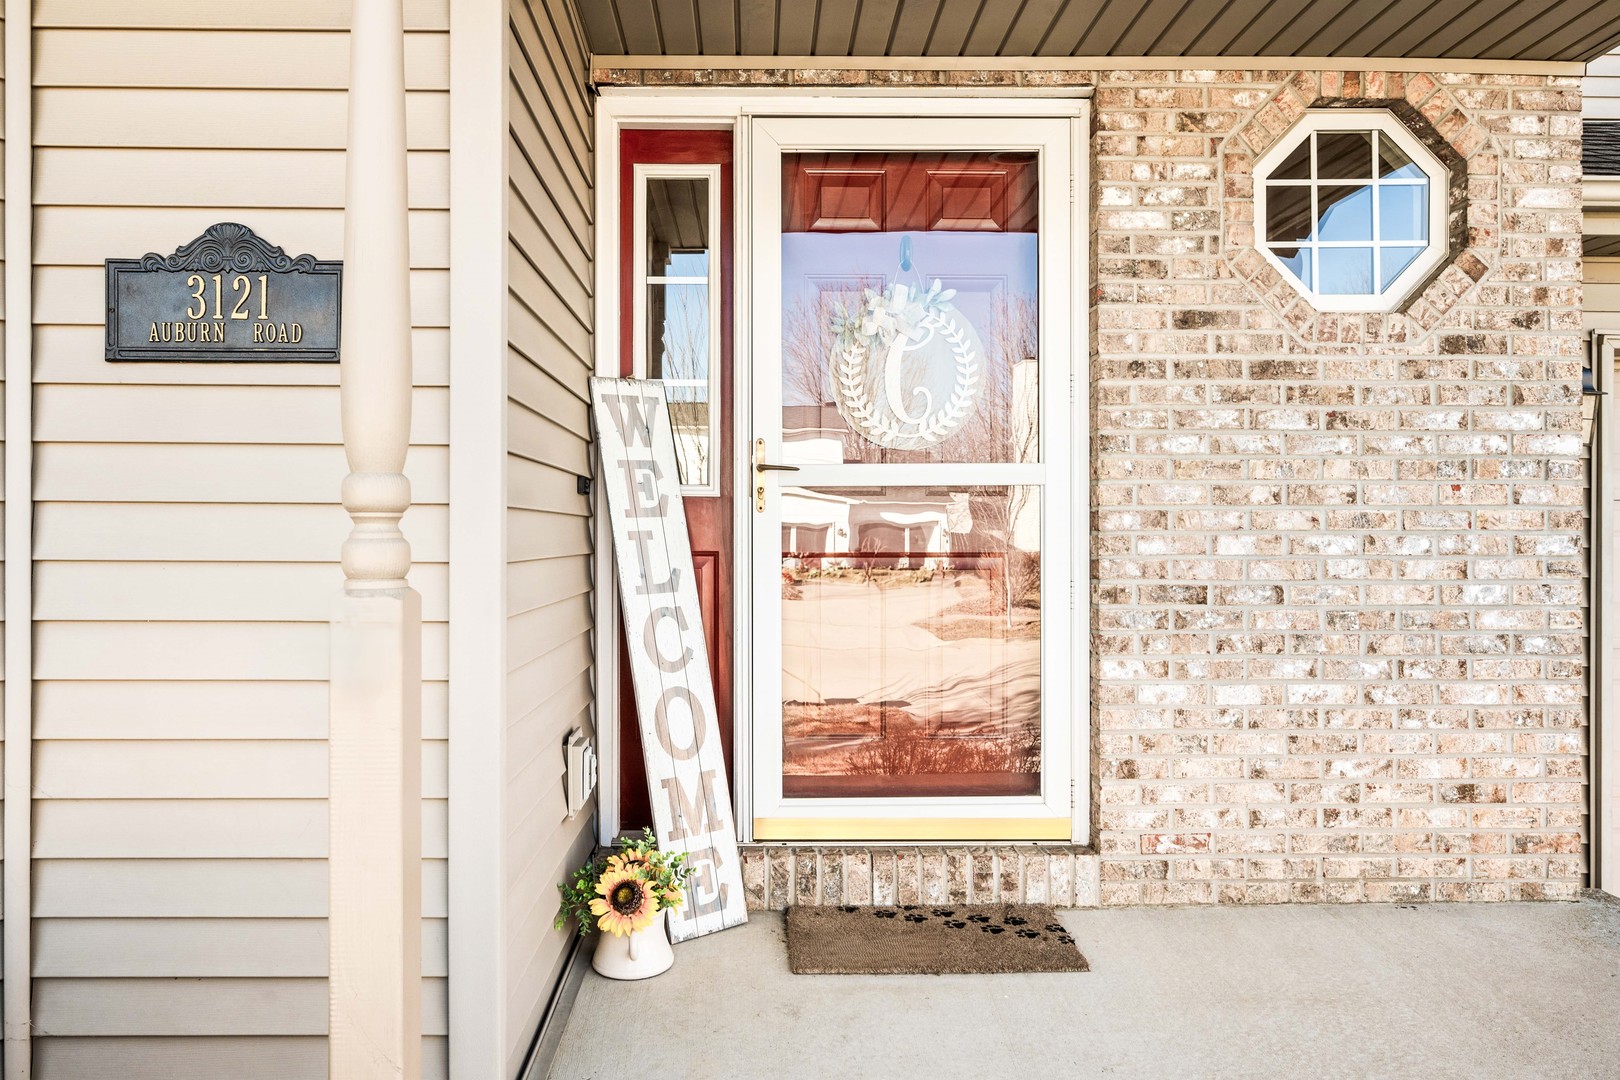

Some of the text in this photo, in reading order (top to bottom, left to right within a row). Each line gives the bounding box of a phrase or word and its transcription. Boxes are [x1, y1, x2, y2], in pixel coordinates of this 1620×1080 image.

[187, 274, 269, 320] 3121
[149, 322, 303, 344] AUBURN ROAD
[602, 394, 729, 920] WELCOME
